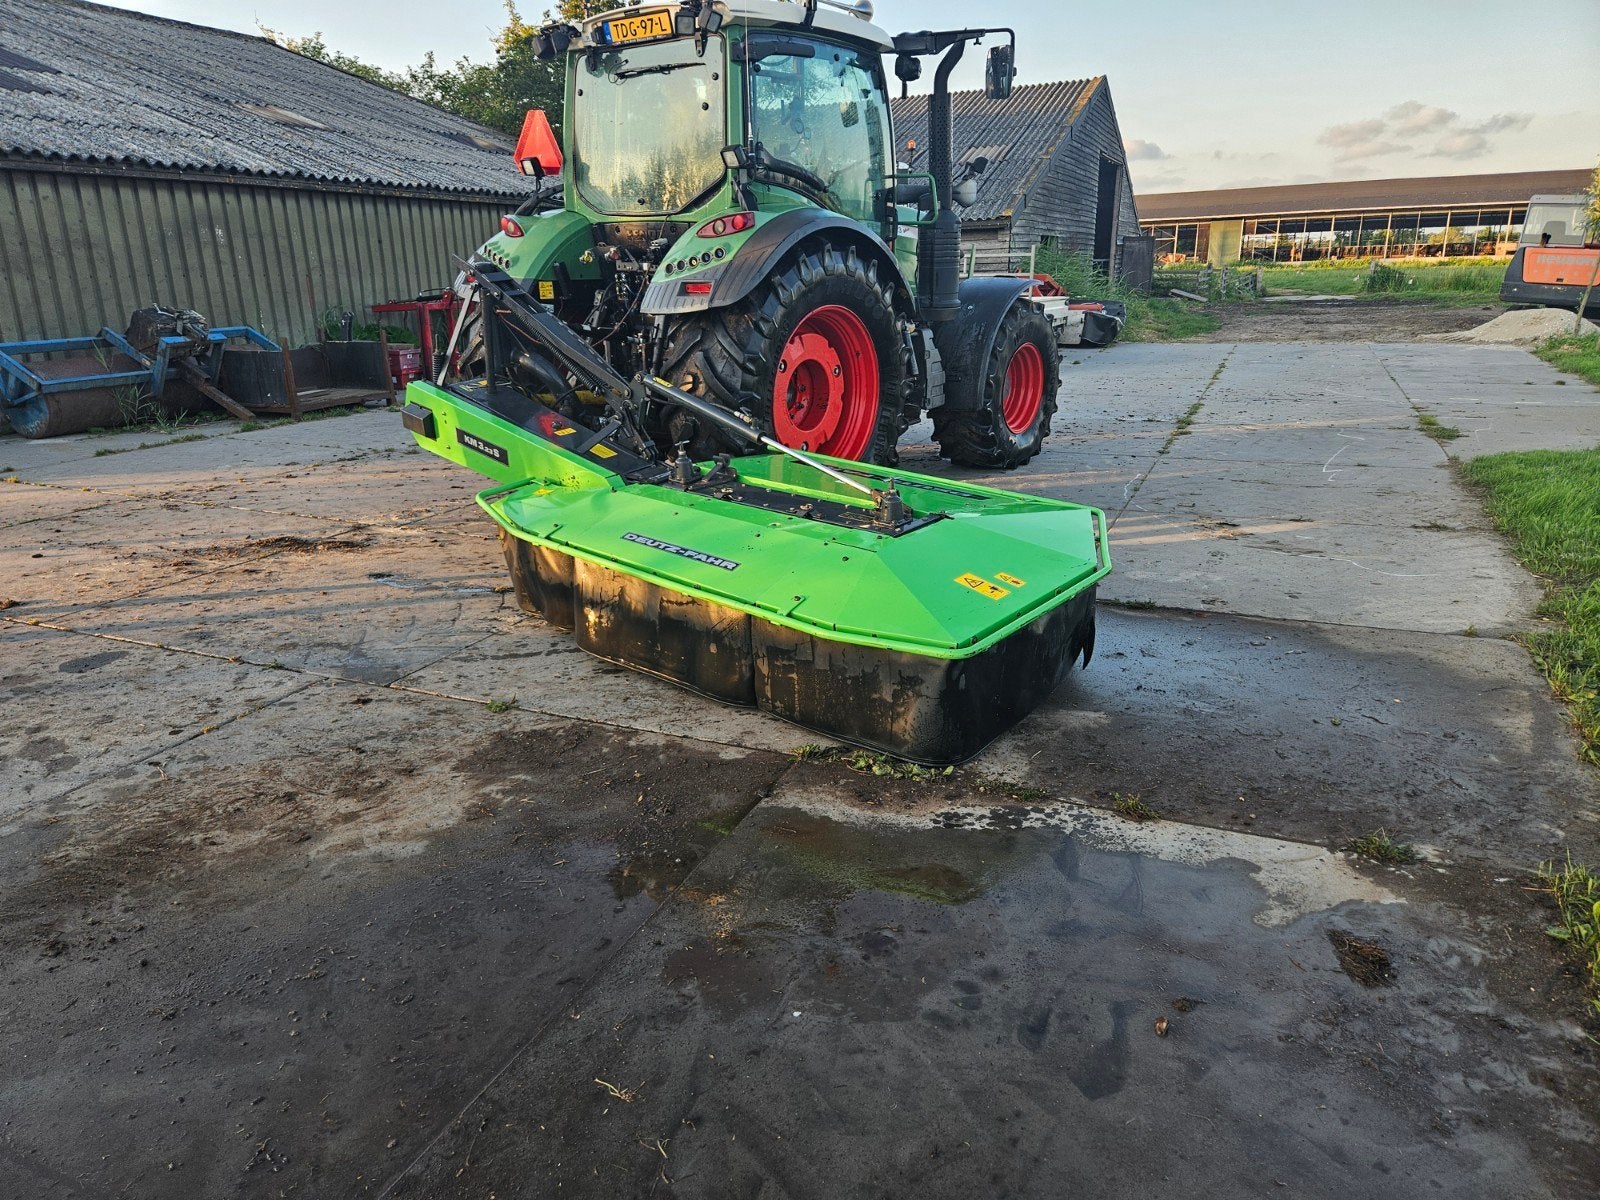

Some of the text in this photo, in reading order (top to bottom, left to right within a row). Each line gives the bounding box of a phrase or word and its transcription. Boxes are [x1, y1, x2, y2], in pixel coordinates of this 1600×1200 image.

[613, 17, 667, 39] TDG-97-L
[464, 435, 478, 448] KM
[624, 533, 737, 570] DEUTZ-FAHR
